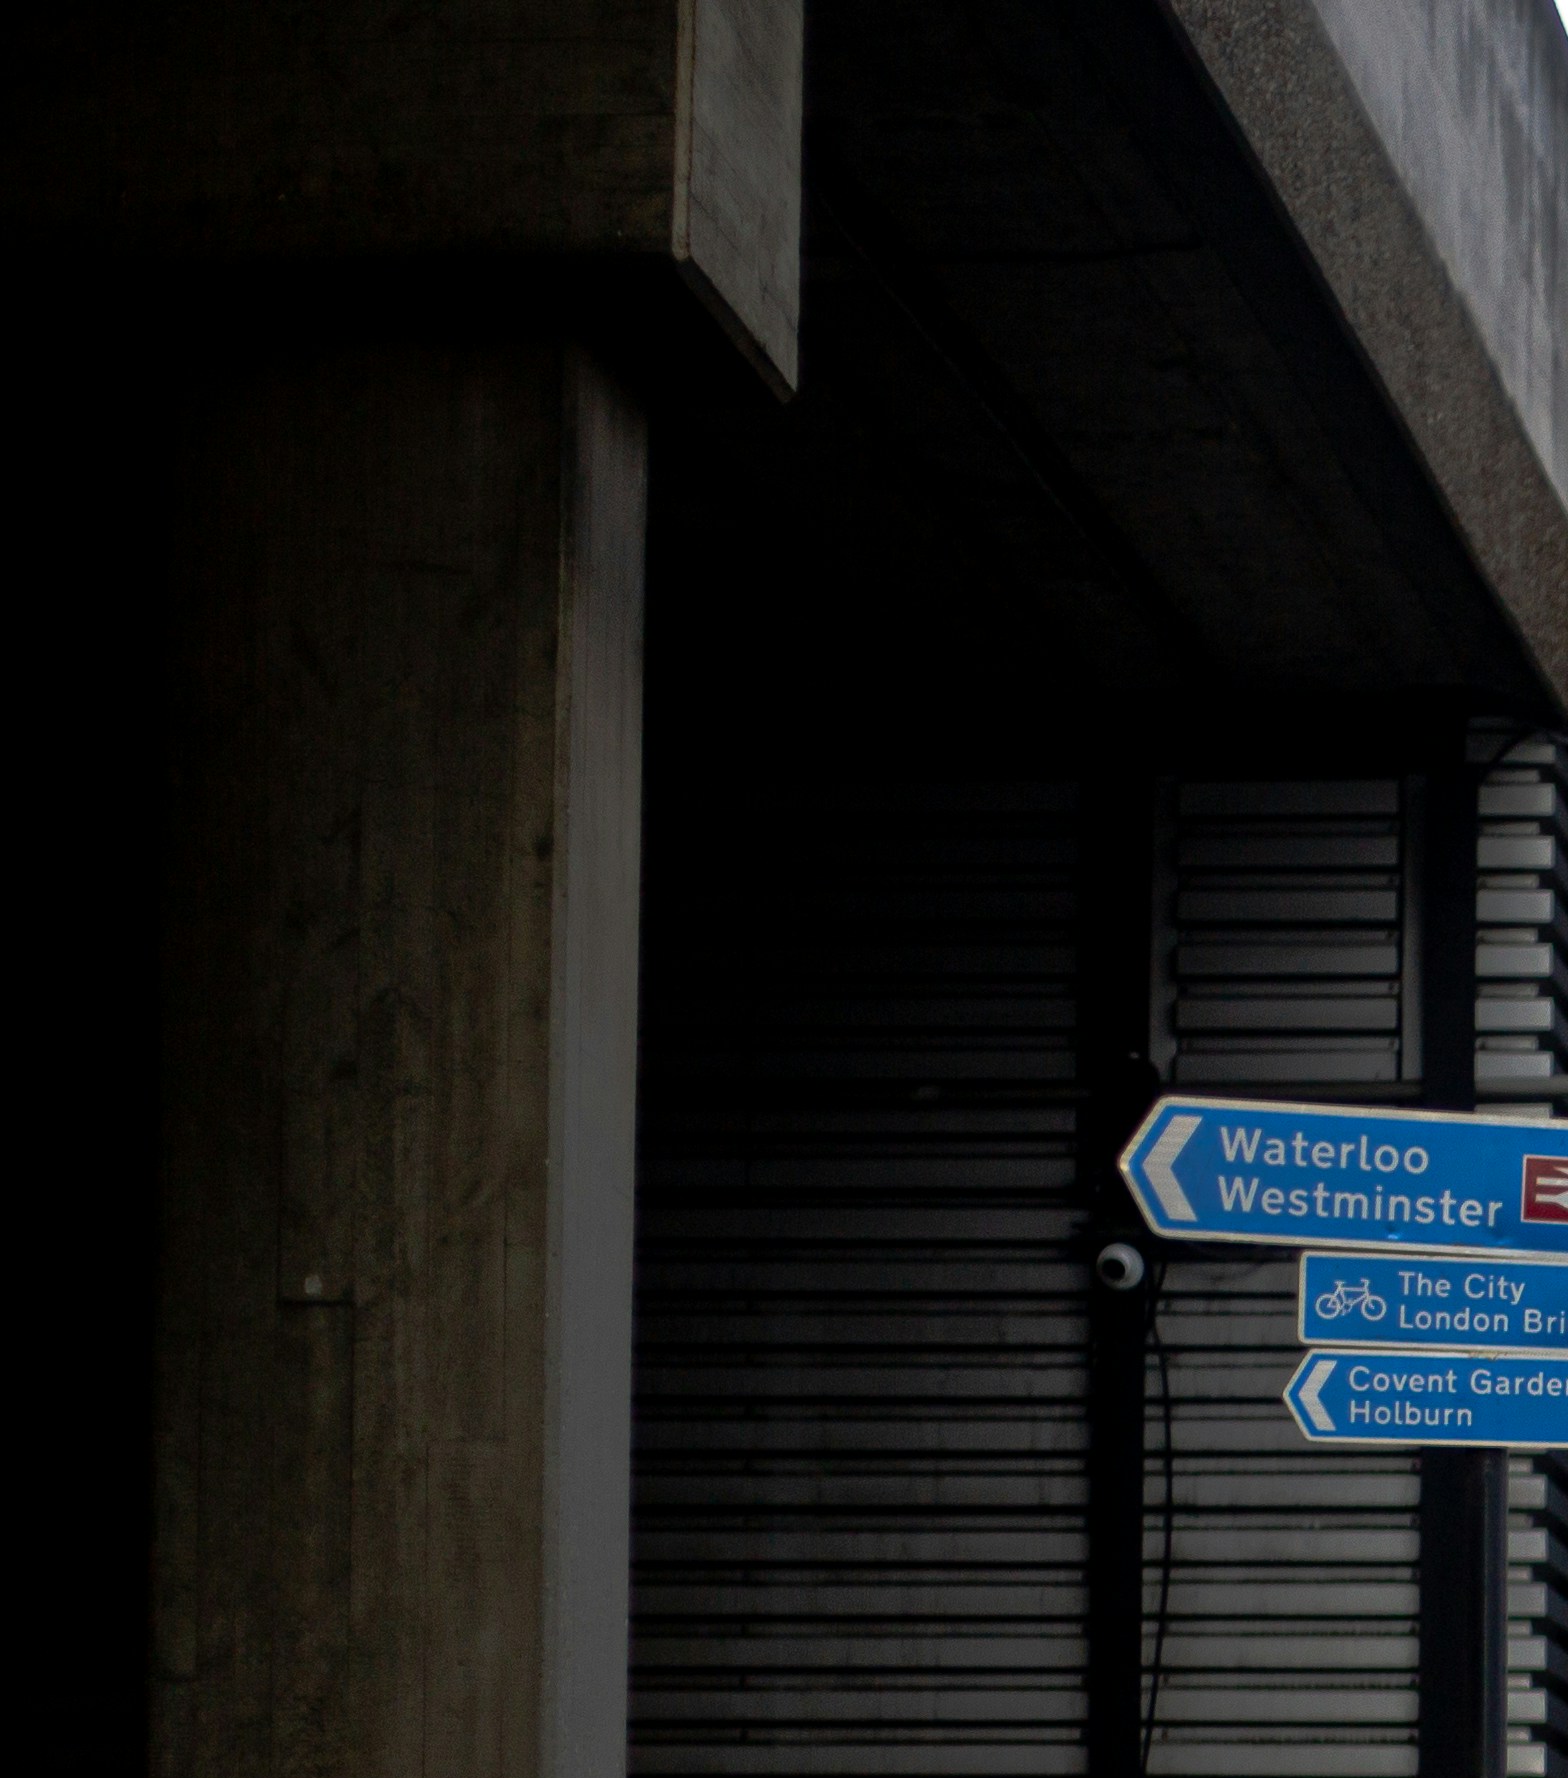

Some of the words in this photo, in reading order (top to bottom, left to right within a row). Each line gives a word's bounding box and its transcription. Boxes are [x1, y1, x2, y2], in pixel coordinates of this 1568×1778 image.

[1219, 1125, 1430, 1175] Waterloo
[1217, 1174, 1504, 1228] Westminster
[1398, 1270, 1452, 1298] The
[1463, 1273, 1526, 1304] City
[1399, 1304, 1510, 1334] London
[1348, 1366, 1458, 1396] Covent
[1348, 1398, 1474, 1428] Holburn
